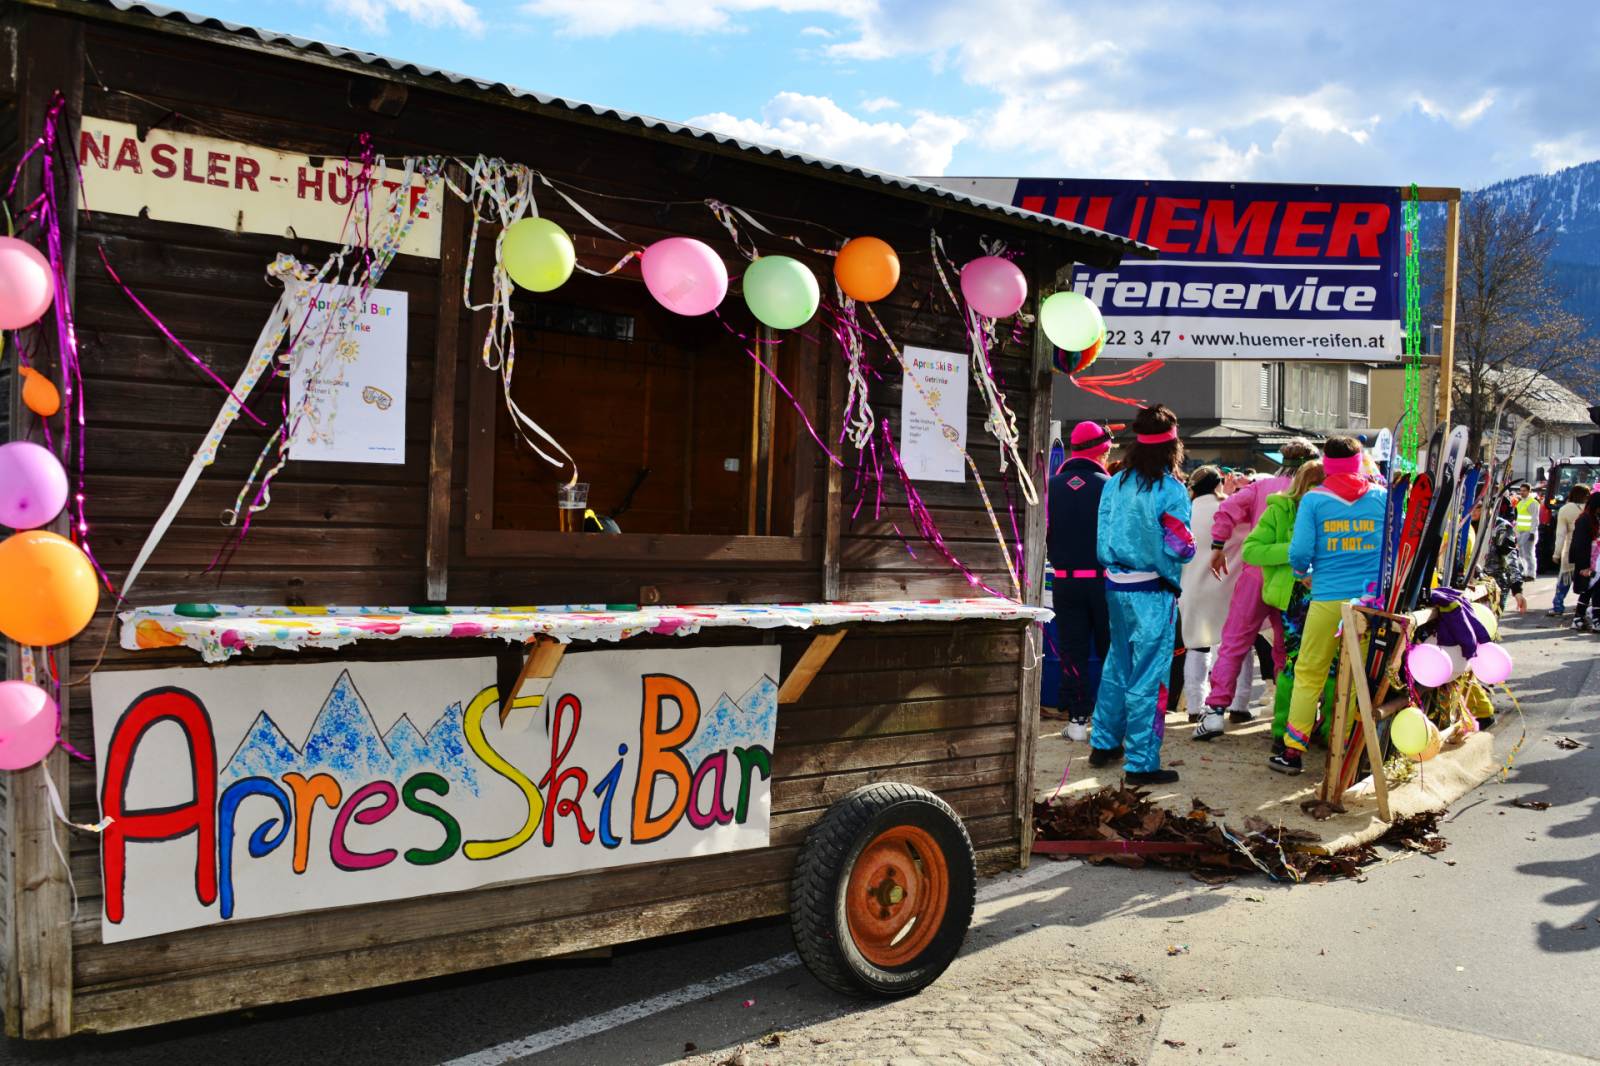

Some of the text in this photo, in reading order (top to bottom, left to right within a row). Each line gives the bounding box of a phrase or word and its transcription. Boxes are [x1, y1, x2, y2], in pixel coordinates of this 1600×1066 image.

[1073, 272, 1377, 312] ifenservice
[370, 303, 392, 316] Bar
[1134, 331, 1144, 345] 3
[1150, 331, 1171, 346] 47
[1191, 332, 1385, 348] www.huemer-reifen.at
[1323, 519, 1375, 533] SOME LIKE
[1327, 537, 1338, 551] IT
